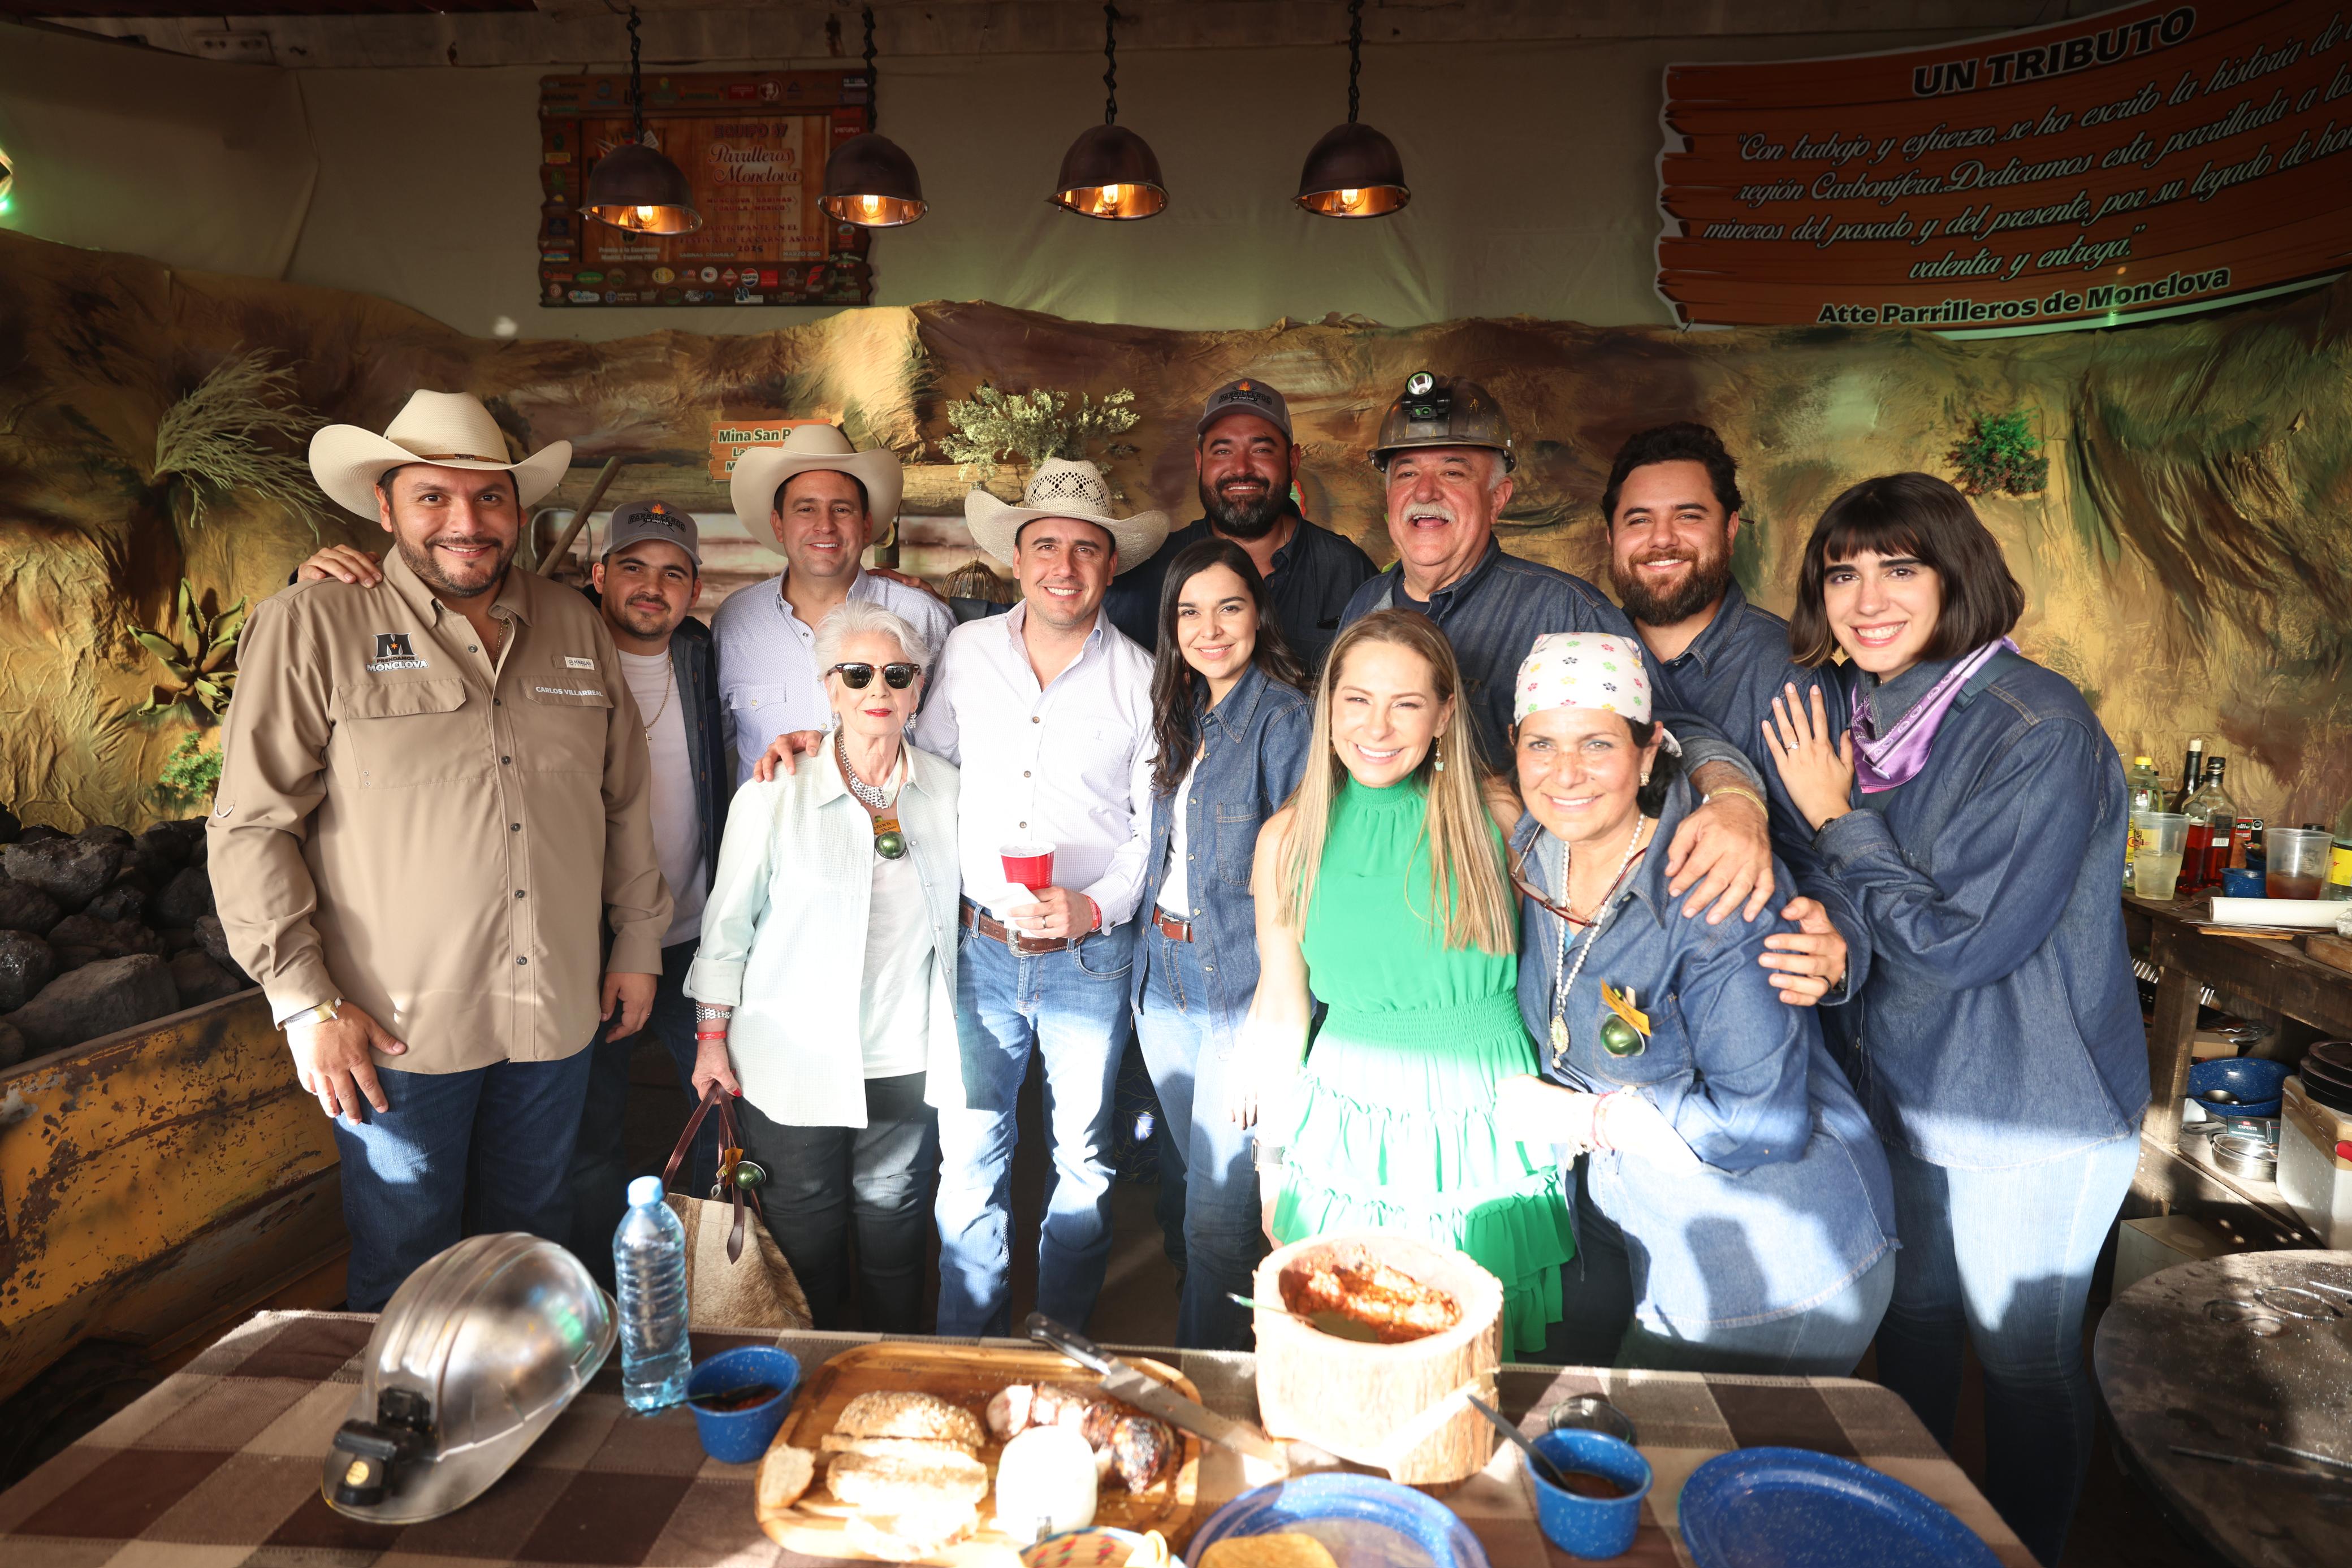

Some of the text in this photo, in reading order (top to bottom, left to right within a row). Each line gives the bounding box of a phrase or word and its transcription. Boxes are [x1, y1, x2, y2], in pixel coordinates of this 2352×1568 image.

[1913, 7, 2195, 96] UN TRIBUTO
[1791, 132, 1870, 167] trabajo
[1868, 137, 1897, 165] y
[1901, 123, 1996, 162] esfuerzo,
[2000, 119, 2034, 141] se
[2034, 104, 2074, 136] ha
[2080, 80, 2162, 128] escrito
[2167, 71, 2200, 106] la
[2203, 37, 2306, 97] historia
[2309, 12, 2344, 57] de
[714, 124, 769, 138] EQUIPO
[708, 144, 793, 163] Parrilleros
[1734, 177, 1806, 209] región
[2100, 131, 2155, 170] esta
[2142, 87, 2290, 170] parrillada
[2295, 85, 2319, 114] a
[714, 163, 798, 183] Monclova
[1702, 218, 1785, 240] mineros
[1791, 214, 1833, 241] del
[1815, 211, 1914, 249] pasado
[1909, 218, 1940, 246] y
[1944, 203, 1992, 236] del
[1973, 189, 2091, 241] presente,
[2081, 188, 2147, 227] por
[2148, 177, 2186, 206] su
[2189, 160, 2275, 203] legado
[2277, 128, 2314, 170] de
[1999, 252, 2033, 281] y
[1817, 266, 2232, 325] Atte Parrilleros de Monclova
[718, 428, 751, 443] Mina
[754, 428, 780, 441] San
[366, 659, 429, 672] MONCLOVA
[535, 686, 563, 695] CARLOS
